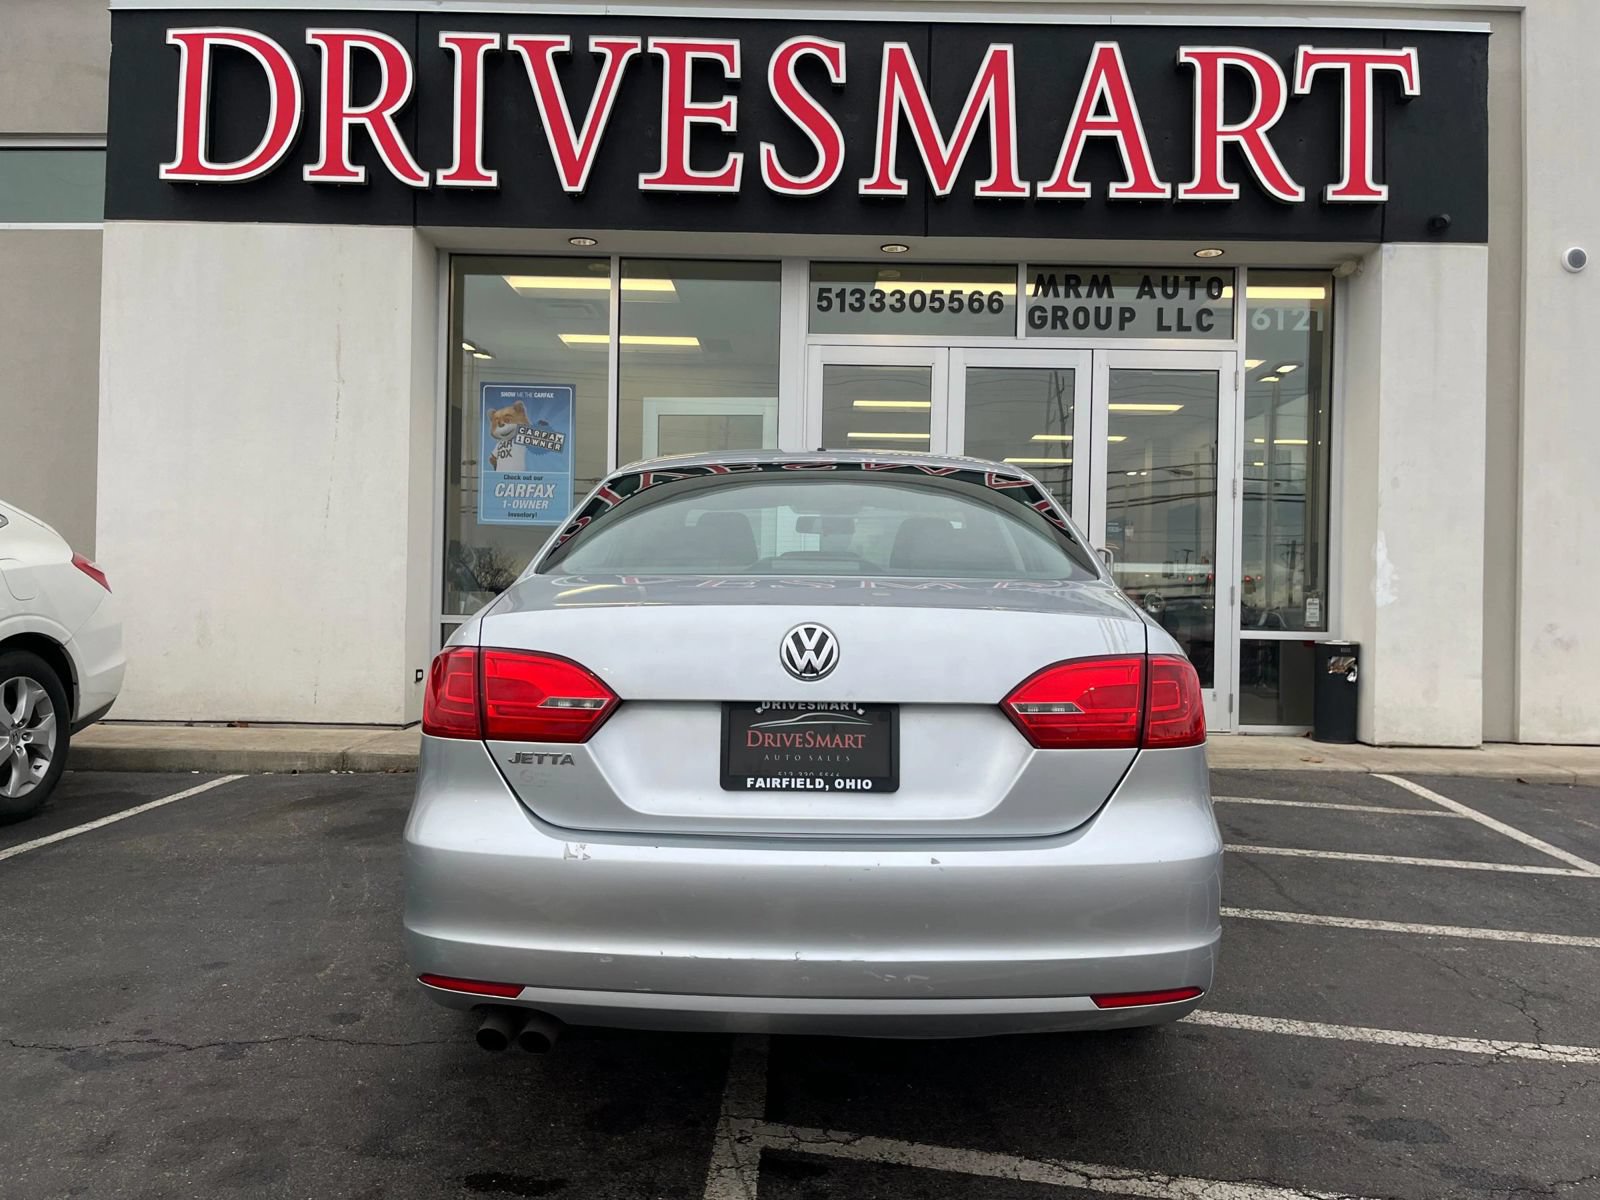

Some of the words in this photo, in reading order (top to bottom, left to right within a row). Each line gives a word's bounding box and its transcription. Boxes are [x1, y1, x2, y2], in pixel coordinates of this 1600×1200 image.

[159, 27, 1421, 204] DRIVESMART
[1032, 273, 1115, 299] MRM
[1136, 275, 1224, 300] AUTO
[816, 287, 1005, 315] 5133305566
[1028, 305, 1136, 331] GROUP
[1157, 307, 1215, 332] LLC
[518, 426, 564, 445] CARFAX
[495, 483, 555, 498] CARFAX
[508, 752, 576, 766] JETTA
[763, 753, 801, 762] AUTO
[809, 754, 851, 763] SALES
[746, 777, 829, 791] FAIRFIELD,
[834, 778, 873, 790] OHIO
